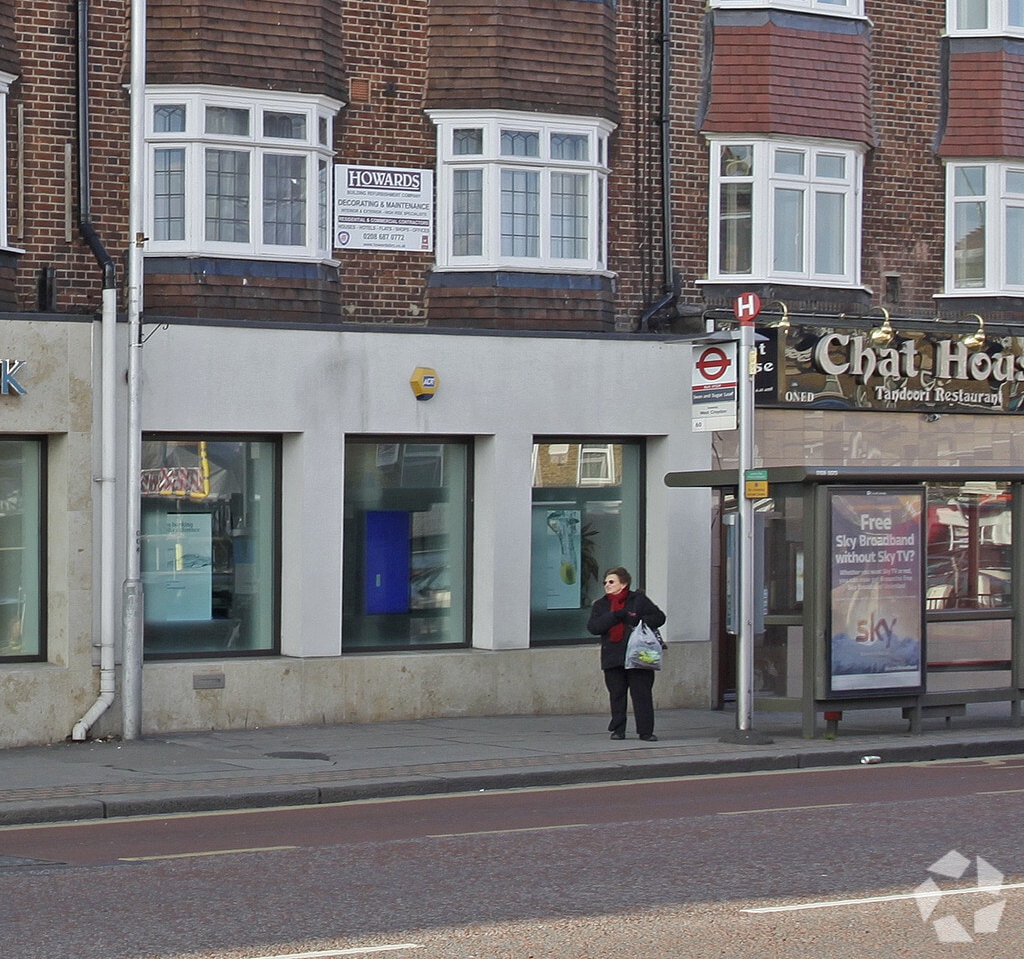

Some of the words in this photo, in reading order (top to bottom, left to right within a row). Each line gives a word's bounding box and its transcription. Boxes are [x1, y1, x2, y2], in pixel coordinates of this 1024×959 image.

[349, 171, 420, 188] HOWARDS
[338, 199, 379, 208] DECORATING
[386, 201, 430, 210] MAINTENANCE
[737, 295, 755, 318] H
[814, 333, 919, 385] Chat
[875, 386, 930, 402] Tandoori
[935, 387, 1003, 405] Restaurant
[860, 513, 892, 531] Free
[836, 535, 857, 550] Sky
[859, 533, 915, 547] Broadband
[835, 550, 876, 564] without
[878, 550, 896, 565] Sky
[896, 549, 915, 562] TV?
[855, 611, 897, 649] sky
